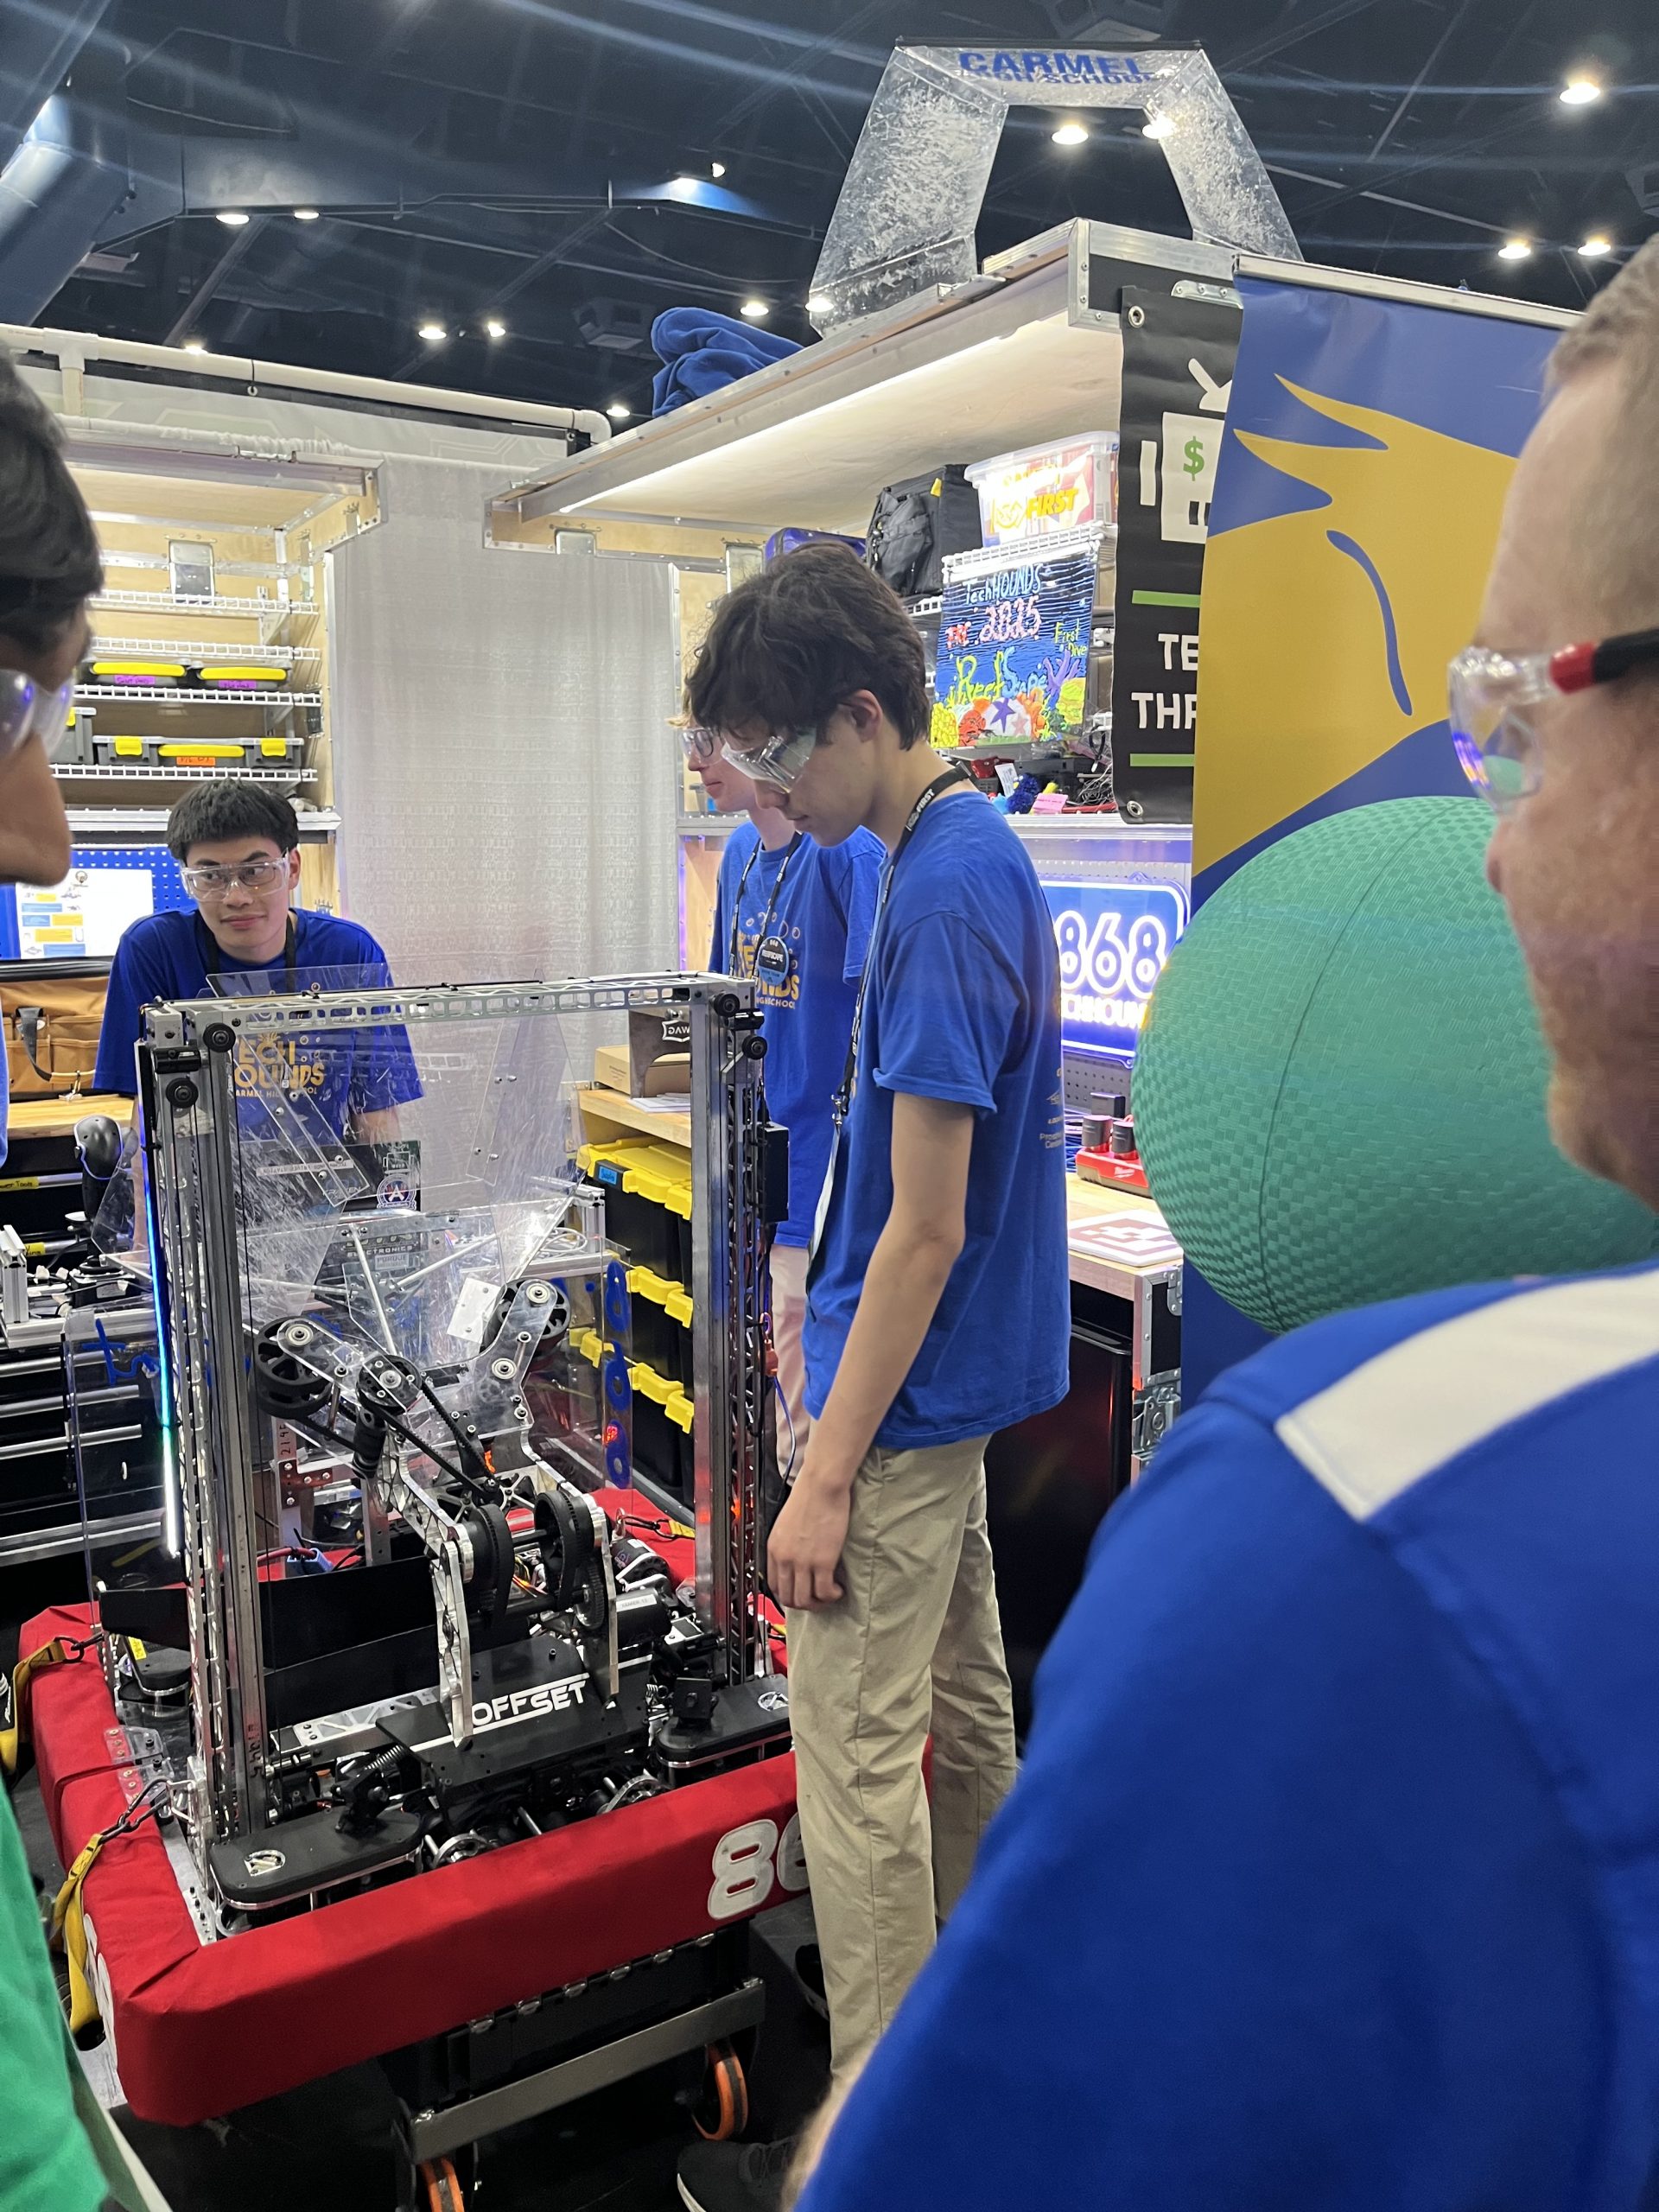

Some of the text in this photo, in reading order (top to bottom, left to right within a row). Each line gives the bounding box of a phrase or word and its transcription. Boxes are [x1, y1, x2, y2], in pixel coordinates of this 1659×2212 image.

[958, 52, 1156, 75] CARMEL
[1025, 487, 1080, 519] FIRST
[962, 563, 1044, 605] TechHOUNDS
[979, 594, 1042, 643] 2025
[1054, 618, 1080, 644] First
[1158, 632, 1199, 671] TE
[1053, 910, 1166, 999] 868
[346, 1245, 413, 1258] ELCTRONICS
[471, 1679, 587, 1726] OFFSET
